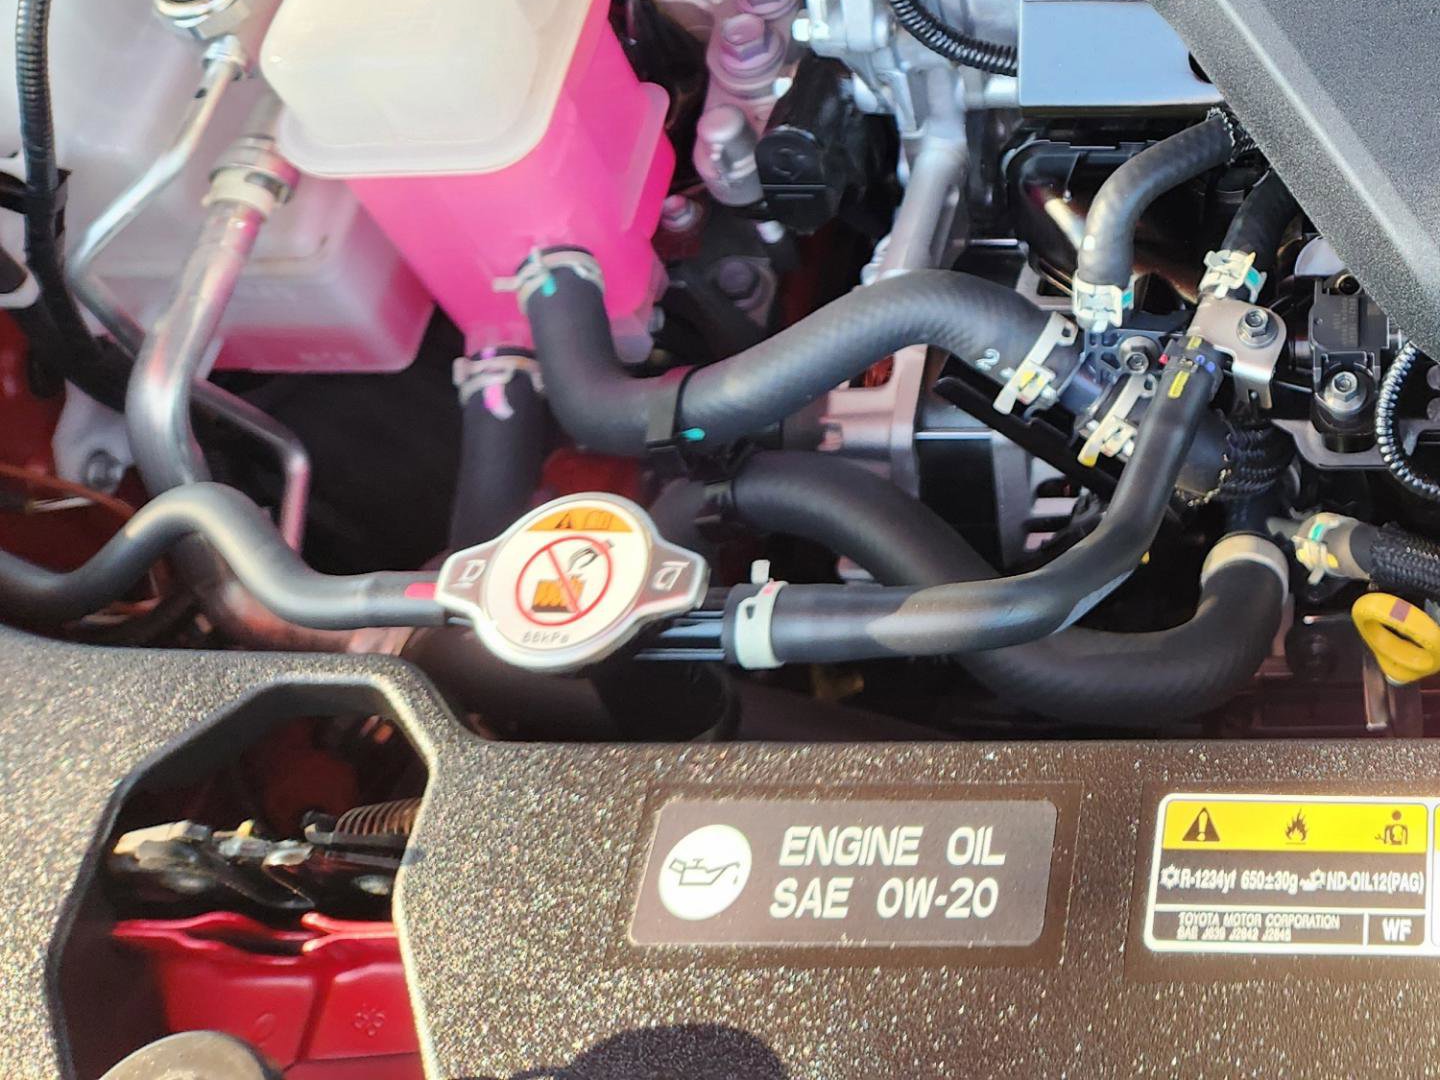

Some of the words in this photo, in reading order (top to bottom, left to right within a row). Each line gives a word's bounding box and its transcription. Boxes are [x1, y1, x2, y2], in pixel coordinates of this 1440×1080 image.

[778, 826, 924, 866] ENGINE
[946, 825, 1007, 866] OIL
[1241, 870, 1299, 895] 650±30g
[769, 876, 855, 919] SAE
[876, 876, 999, 919] 0W-20
[1178, 912, 1219, 926] TOYOTA
[1223, 913, 1262, 927] MOTOR
[1265, 913, 1340, 930] CORPORATION
[1382, 918, 1413, 941] WF
